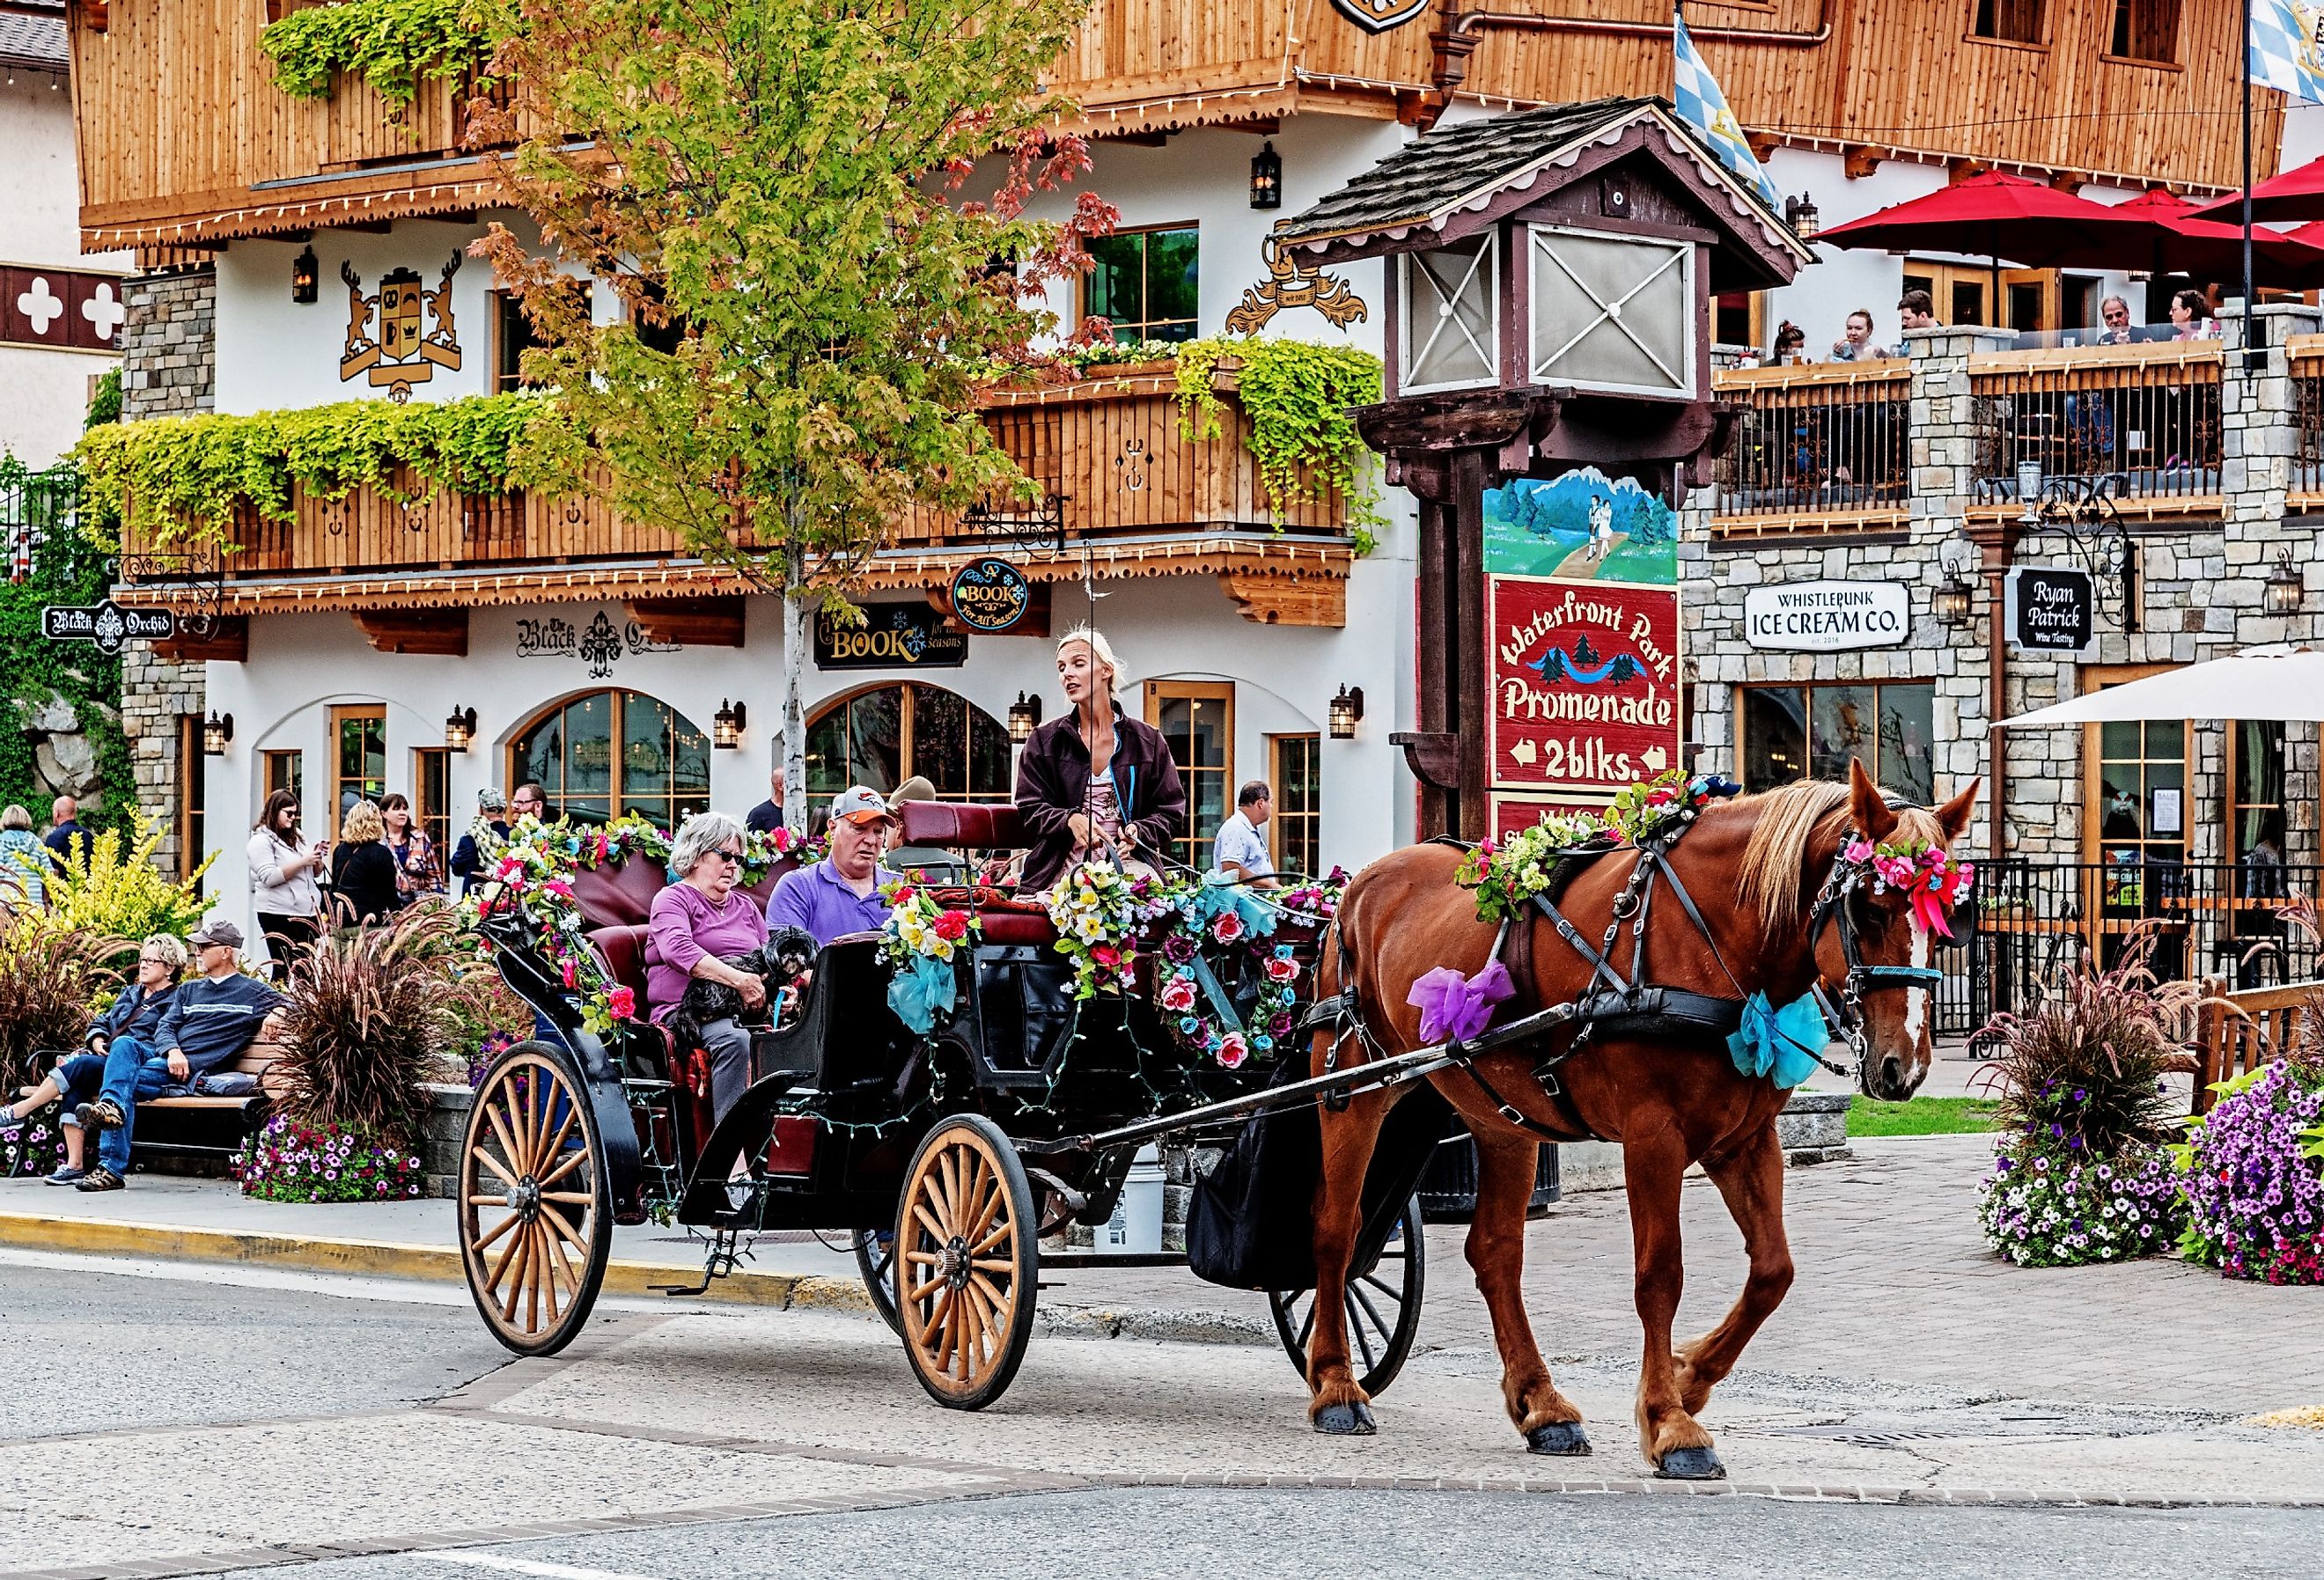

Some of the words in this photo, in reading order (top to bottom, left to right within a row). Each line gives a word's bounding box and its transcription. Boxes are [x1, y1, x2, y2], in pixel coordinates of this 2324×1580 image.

[966, 585, 1021, 606] BOOK
[1778, 592, 1873, 607] WHISTLEPUNK
[2034, 581, 2074, 610] Ryan
[51, 611, 92, 634] Black
[126, 611, 169, 635] Orchid
[549, 618, 565, 632] The
[960, 604, 976, 619] For
[974, 615, 992, 626] All
[991, 605, 1020, 626] Seasons
[1753, 614, 1783, 636] ICE
[1787, 611, 1860, 635] CREAM
[1865, 610, 1900, 632] CO.
[2028, 604, 2080, 627] Patrick
[516, 619, 576, 652] Black
[831, 629, 920, 663] BOOK
[1500, 590, 1623, 666] Waterfront
[1629, 612, 1675, 683] Park
[2035, 631, 2051, 643] Wine
[2052, 630, 2074, 648] Tasting
[1499, 677, 1672, 726] Promenade
[1543, 737, 1640, 782] 2blks.
